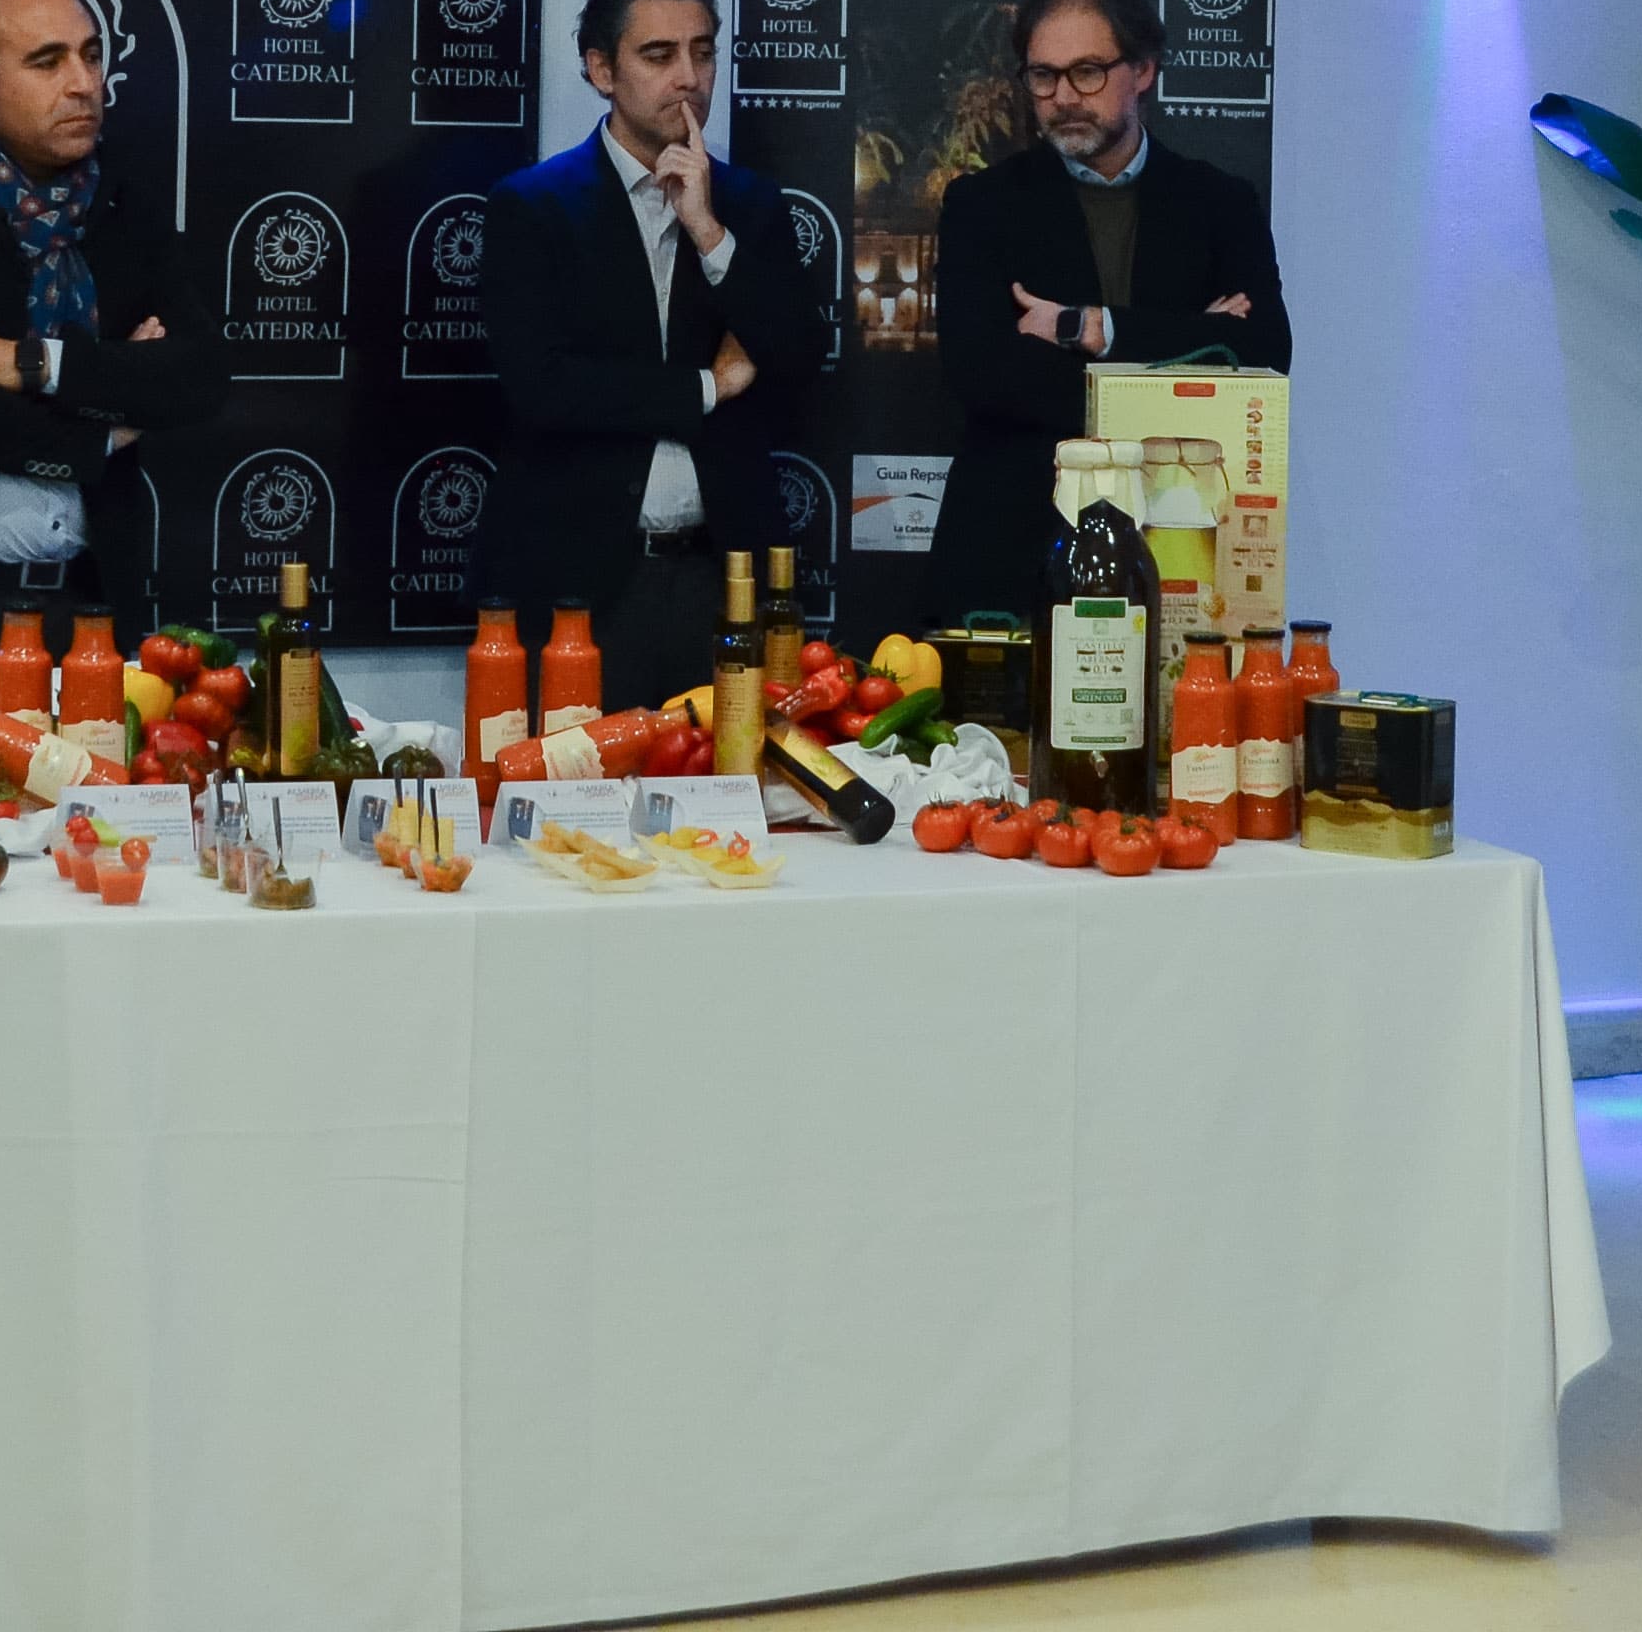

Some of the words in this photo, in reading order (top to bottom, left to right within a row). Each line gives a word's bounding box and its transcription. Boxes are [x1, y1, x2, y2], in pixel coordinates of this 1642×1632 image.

[762, 19, 818, 33] HOTEL
[1188, 28, 1244, 42] HOTEL
[263, 37, 325, 55] HOTEL
[442, 42, 499, 60] HOTEL
[733, 41, 847, 60] CATEDRAL
[230, 62, 356, 85] CATEDRAL
[411, 67, 526, 88] CATEDRAL
[795, 97, 843, 111] Superior
[1221, 107, 1267, 120] Superior
[257, 296, 317, 312] HOTEL
[435, 296, 481, 312] HOTE
[223, 320, 348, 340] CATEDRAL
[403, 321, 489, 340] CATEDR
[910, 468, 949, 484] Repso
[421, 548, 470, 564] HOTE
[390, 572, 465, 592] CATED
